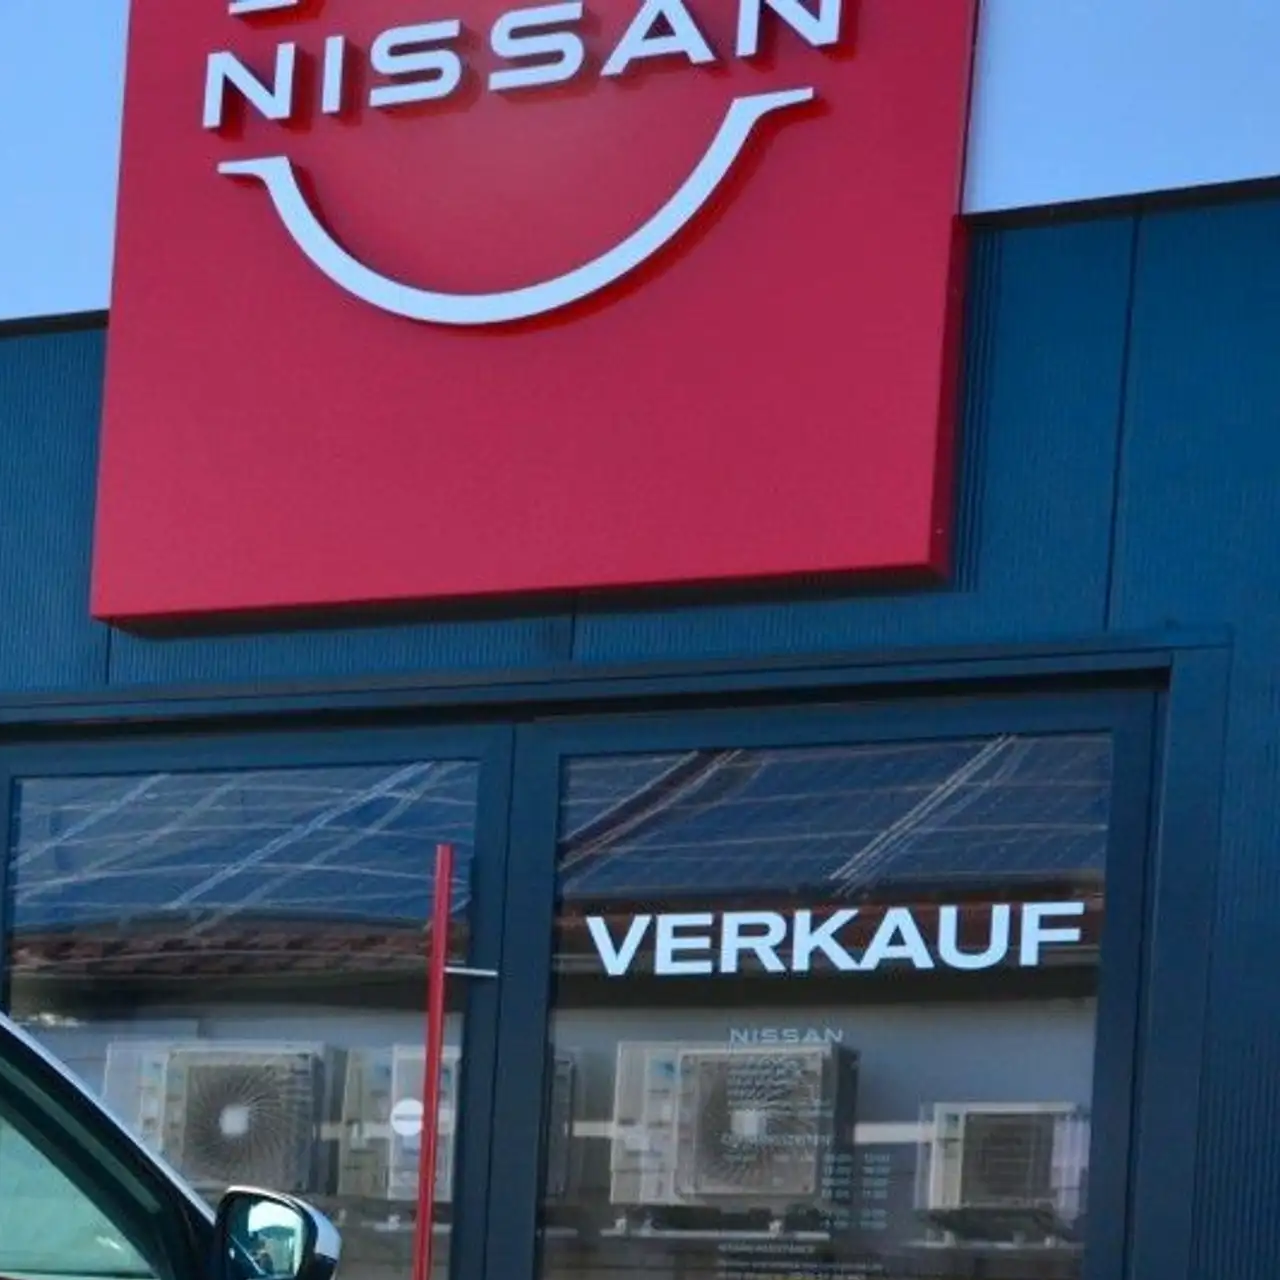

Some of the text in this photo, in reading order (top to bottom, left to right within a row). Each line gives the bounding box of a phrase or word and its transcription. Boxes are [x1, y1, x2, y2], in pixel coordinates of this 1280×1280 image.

[203, 0, 844, 129] NISSAN
[585, 902, 1085, 976] VERKAUF
[730, 1027, 843, 1044] NISSAN
